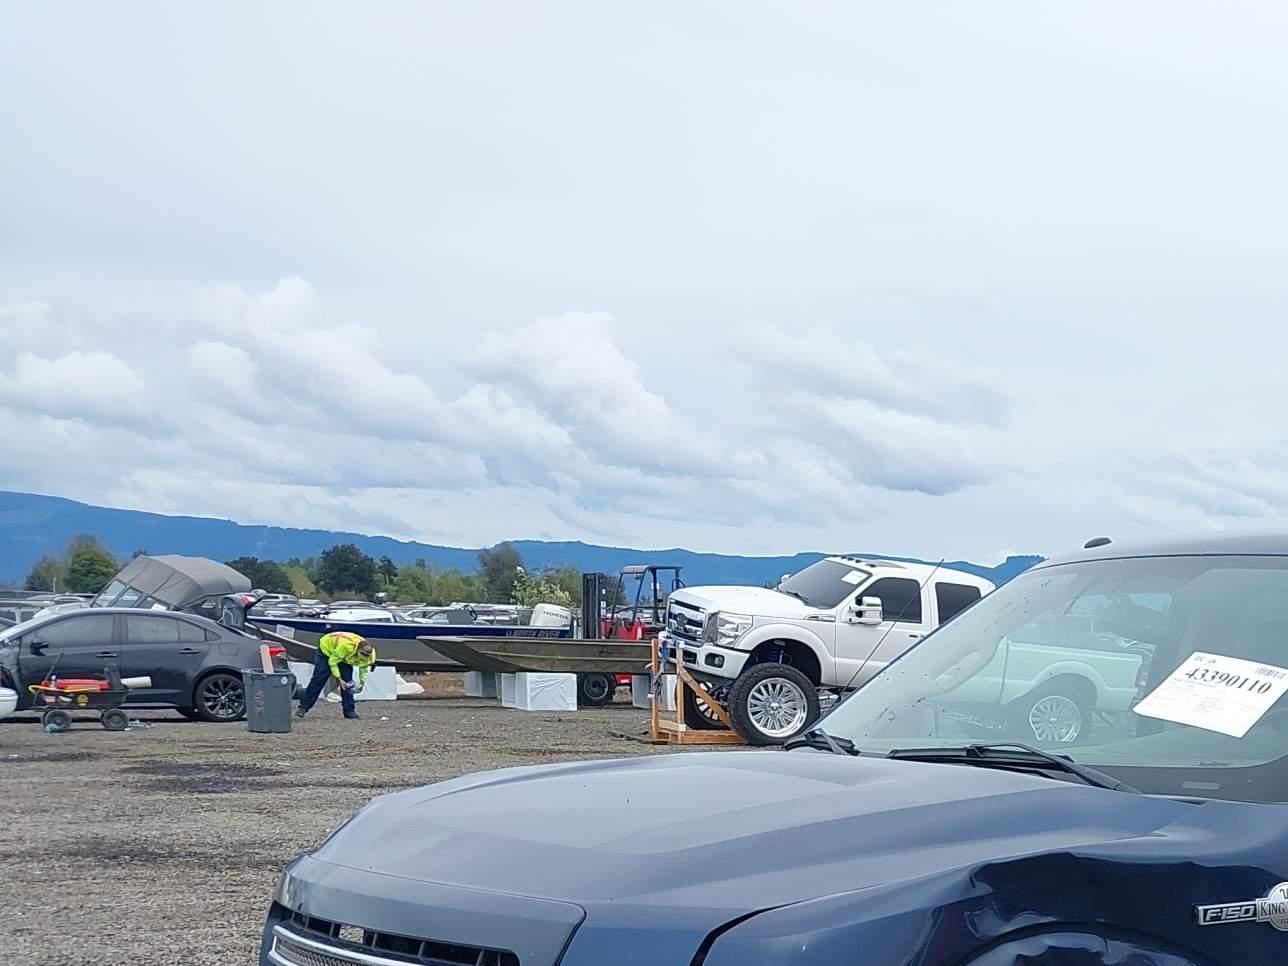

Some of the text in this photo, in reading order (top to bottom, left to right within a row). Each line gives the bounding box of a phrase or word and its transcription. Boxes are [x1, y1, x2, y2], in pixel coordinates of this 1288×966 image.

[543, 610, 569, 620] HONDA
[1185, 668, 1273, 695] 43390110
[1260, 901, 1285, 916] KING
